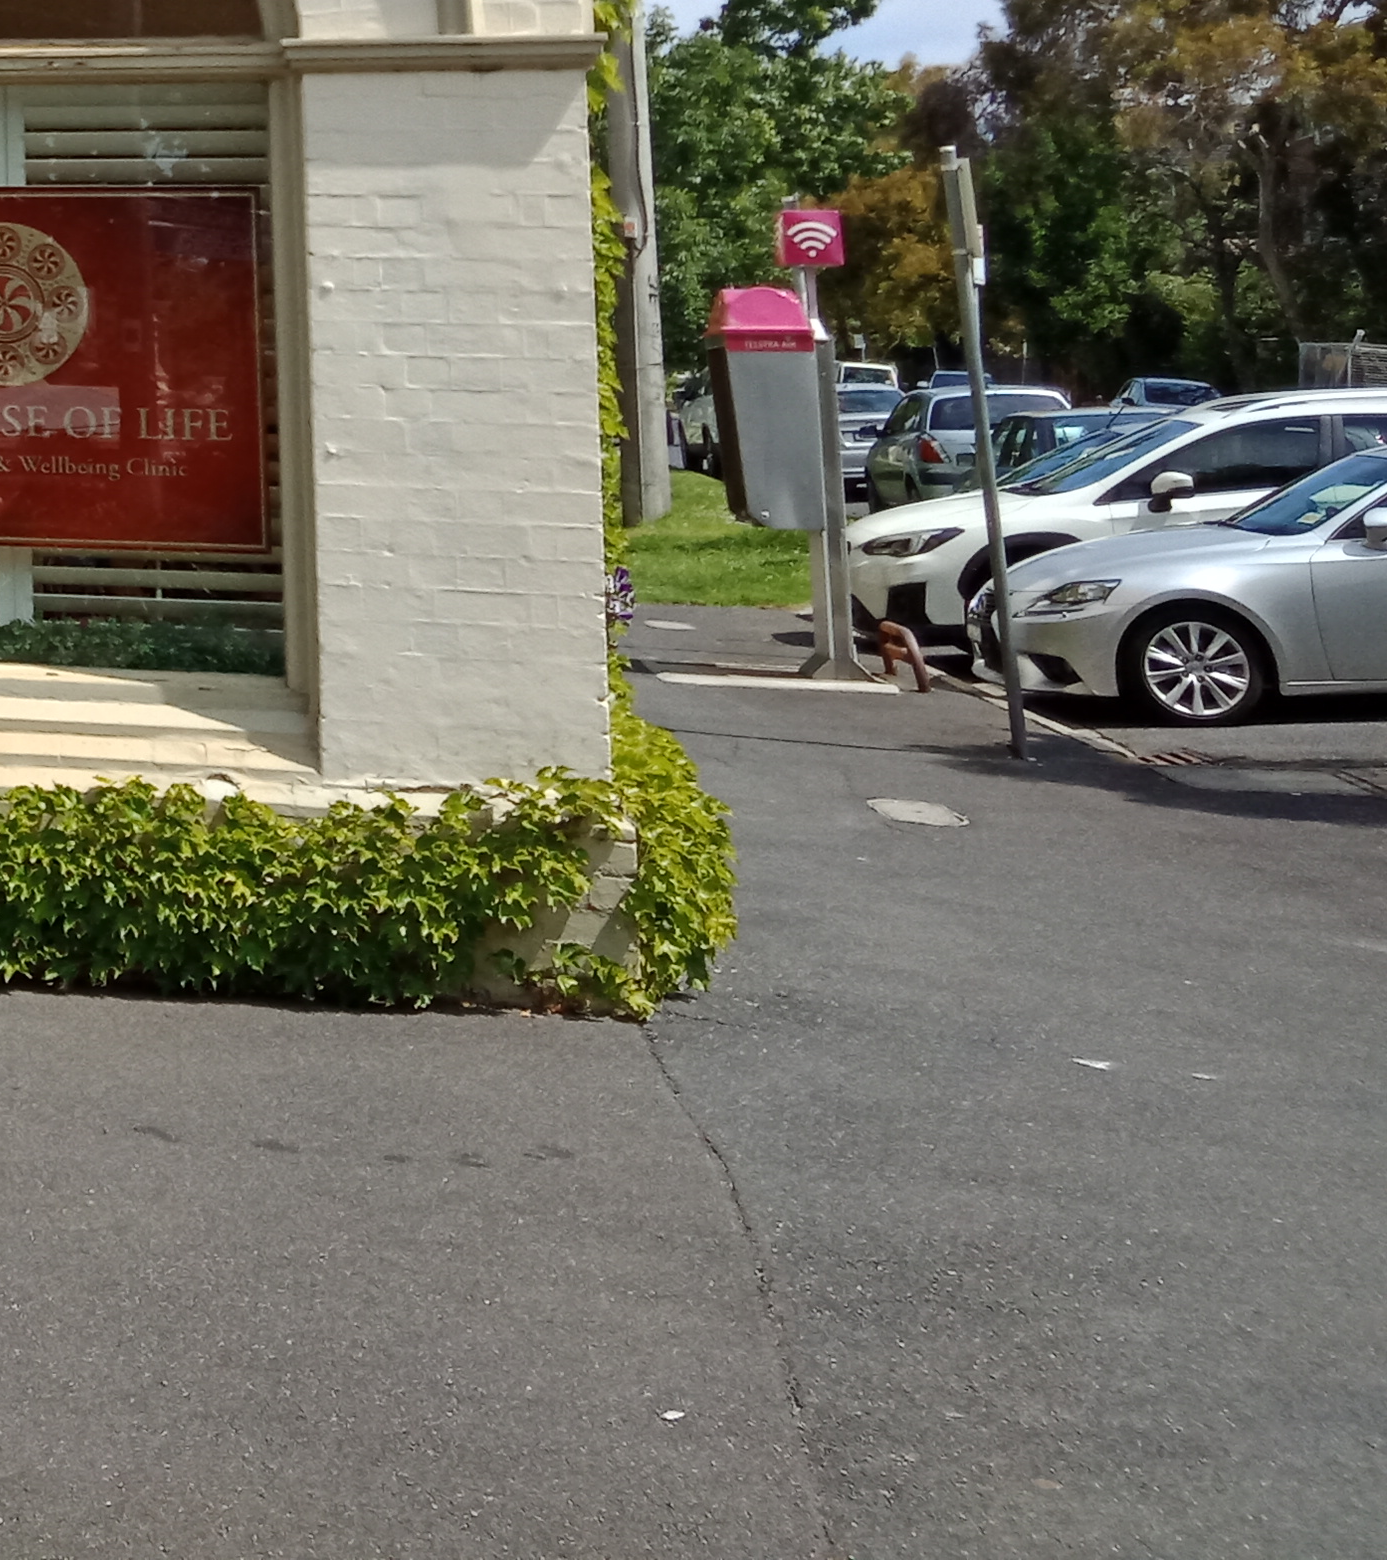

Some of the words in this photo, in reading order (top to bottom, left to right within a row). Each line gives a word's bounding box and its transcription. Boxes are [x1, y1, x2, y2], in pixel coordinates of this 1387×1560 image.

[62, 405, 122, 439] OF
[136, 406, 233, 441] LIFE
[18, 454, 121, 481] Wellbeing
[126, 456, 189, 477] Clinic
